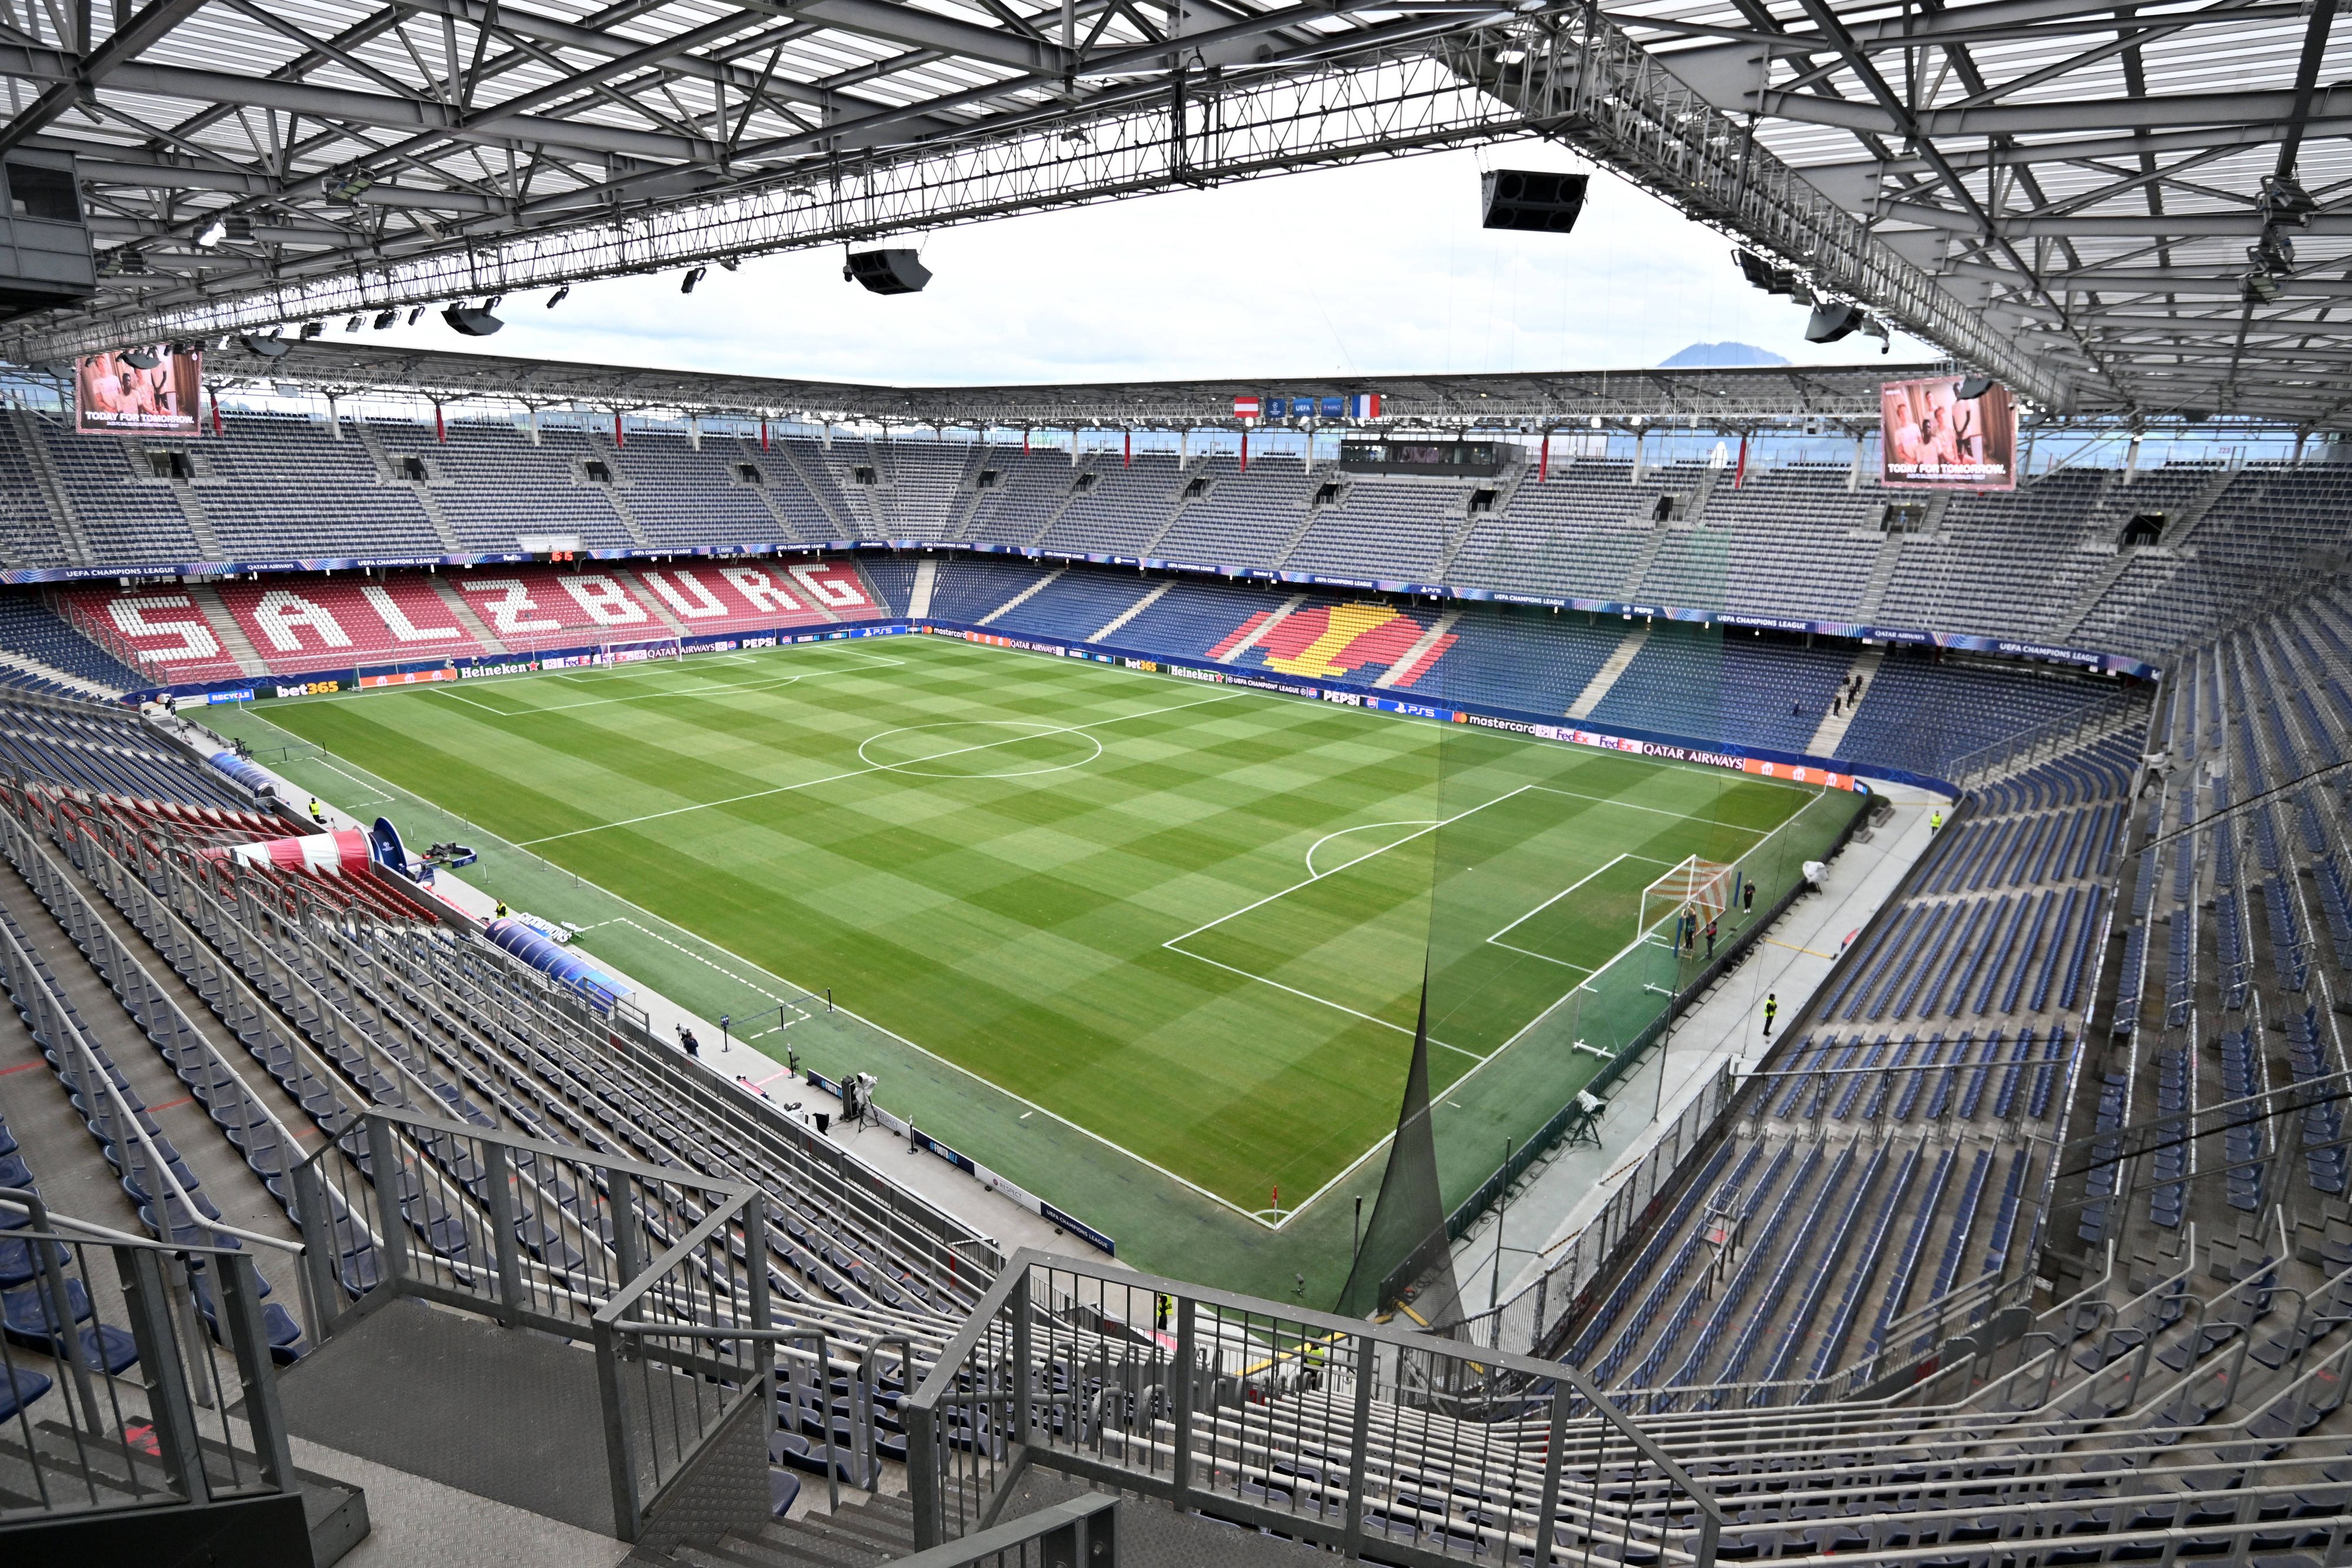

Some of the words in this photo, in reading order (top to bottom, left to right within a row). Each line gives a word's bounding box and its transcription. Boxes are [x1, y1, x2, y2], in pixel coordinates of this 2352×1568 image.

[85, 412, 118, 421] TODAY
[120, 413, 139, 422] FOR
[141, 414, 195, 424] TOMORROW.
[1887, 463, 1919, 473] TODAY
[1919, 464, 1940, 473] FOR
[1940, 464, 2006, 474] TOMORROW.
[66, 569, 90, 577] UEFA
[91, 568, 142, 576] CHAMPIONS
[1327, 578, 1354, 586] CHAMPIONS
[1509, 595, 1542, 604] CHAMPIONS
[1543, 598, 1565, 606] LEAGUE
[108, 563, 866, 663] SALZBURG
[1633, 606, 1654, 614] PEPSI
[1717, 614, 1735, 623] UEFA
[1736, 616, 1777, 627] CHAMPIONS
[1778, 621, 1806, 630] LEAGUE
[934, 627, 966, 638] mastercard
[1875, 630, 1897, 638] QATAR
[1897, 632, 1925, 640] AIRWAYS
[743, 637, 776, 648] PEPSI
[1011, 639, 1030, 650] QATAR
[1032, 642, 1056, 654] AIRWAYS
[647, 647, 677, 658] QATAR
[680, 644, 715, 654] AIRWAYS
[2000, 642, 2021, 653] UEFA
[2023, 645, 2071, 659] CHAMPIONS
[2072, 652, 2099, 664] LEAGUE
[563, 656, 591, 667] FedEx
[1125, 657, 1157, 672] bet365
[460, 662, 527, 678] Heineken
[1171, 665, 1215, 682] Heineken
[276, 681, 339, 698] bet365
[1234, 677, 1247, 686] UEFA
[1279, 684, 1299, 694] LEAGUE
[1324, 690, 1360, 706] PEPSI
[1408, 706, 1435, 717] PS5
[1469, 715, 1535, 734] mastercard
[1556, 728, 1589, 744] FedEx
[1599, 736, 1633, 752] FedEx
[1643, 744, 1685, 760] QATAR
[1689, 754, 1743, 770] AIRWAYS
[517, 912, 572, 943] CHAMPIONS
[879, 1112, 898, 1129] RESPECT
[929, 1141, 958, 1165] #FOOTBALL
[1000, 1182, 1022, 1199] RESPECT
[1047, 1209, 1059, 1221] UEFA
[1060, 1217, 1088, 1237] CHAMPIONS
[1088, 1233, 1108, 1249] LEAGUE
